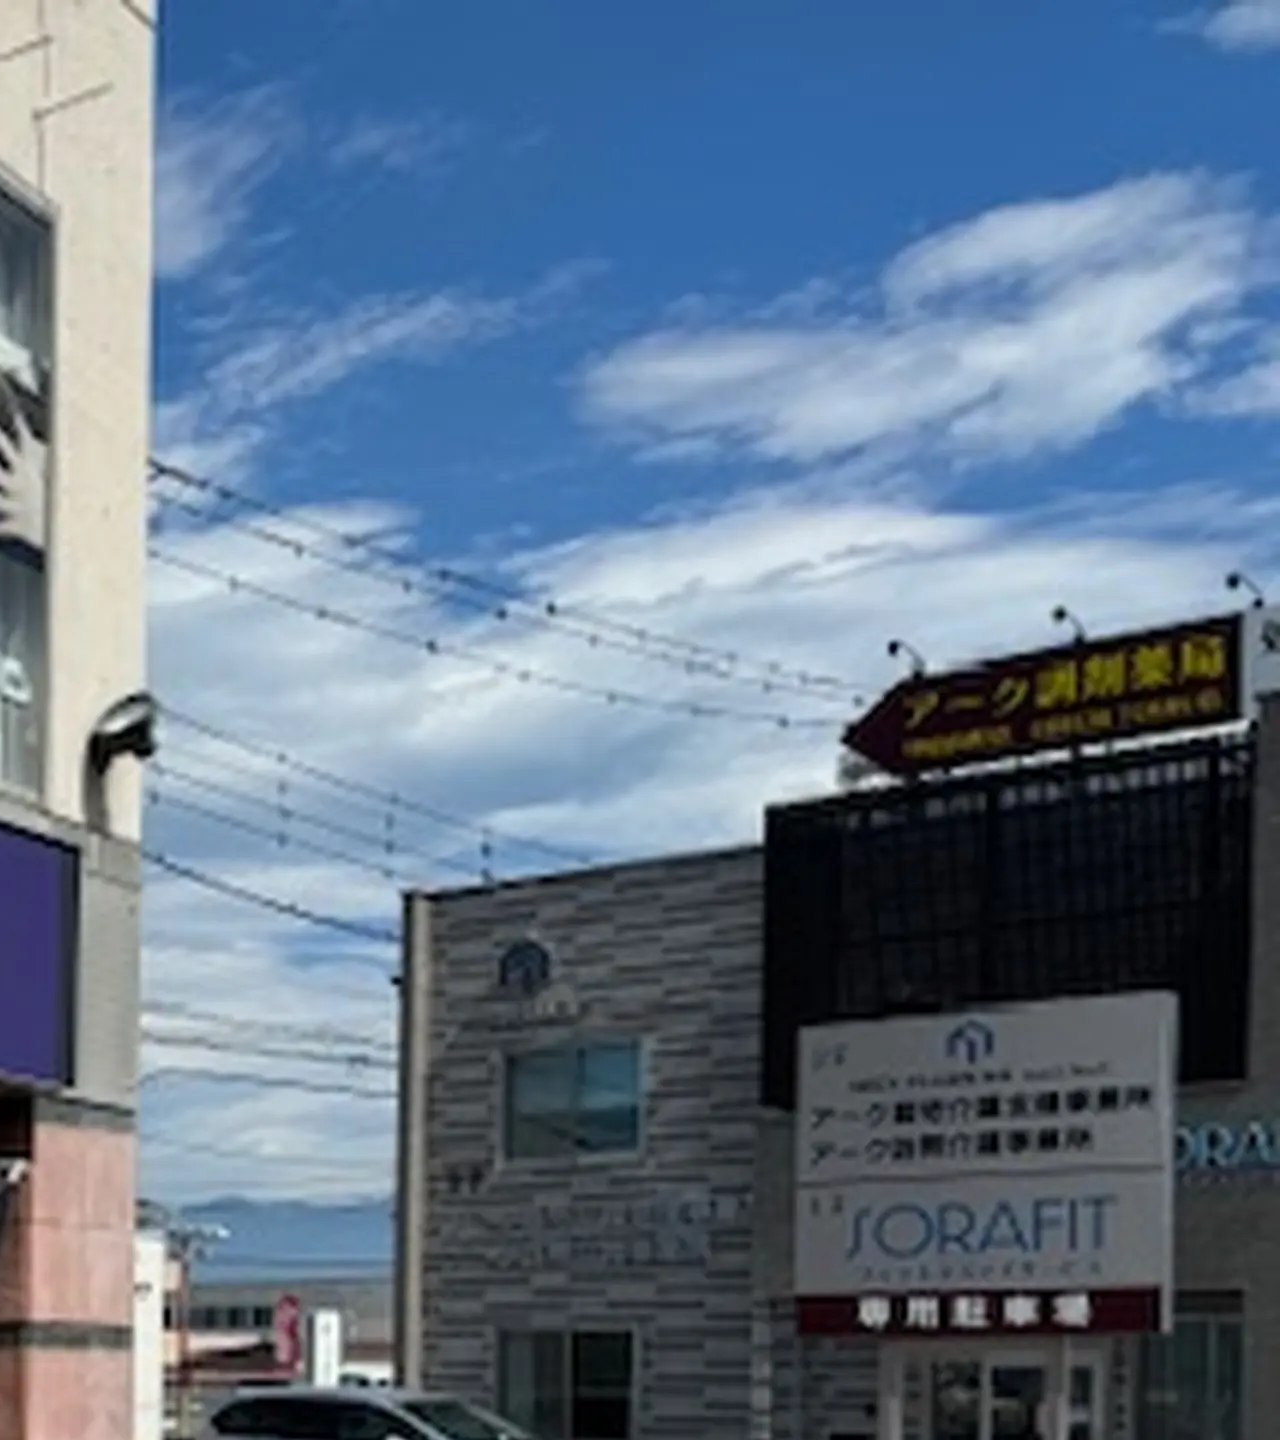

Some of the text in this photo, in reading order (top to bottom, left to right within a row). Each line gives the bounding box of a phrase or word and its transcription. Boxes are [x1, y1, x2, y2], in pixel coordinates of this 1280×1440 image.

[845, 1194, 1120, 1261] SORAFIT
[857, 1291, 1093, 1332] 専用駐車場
